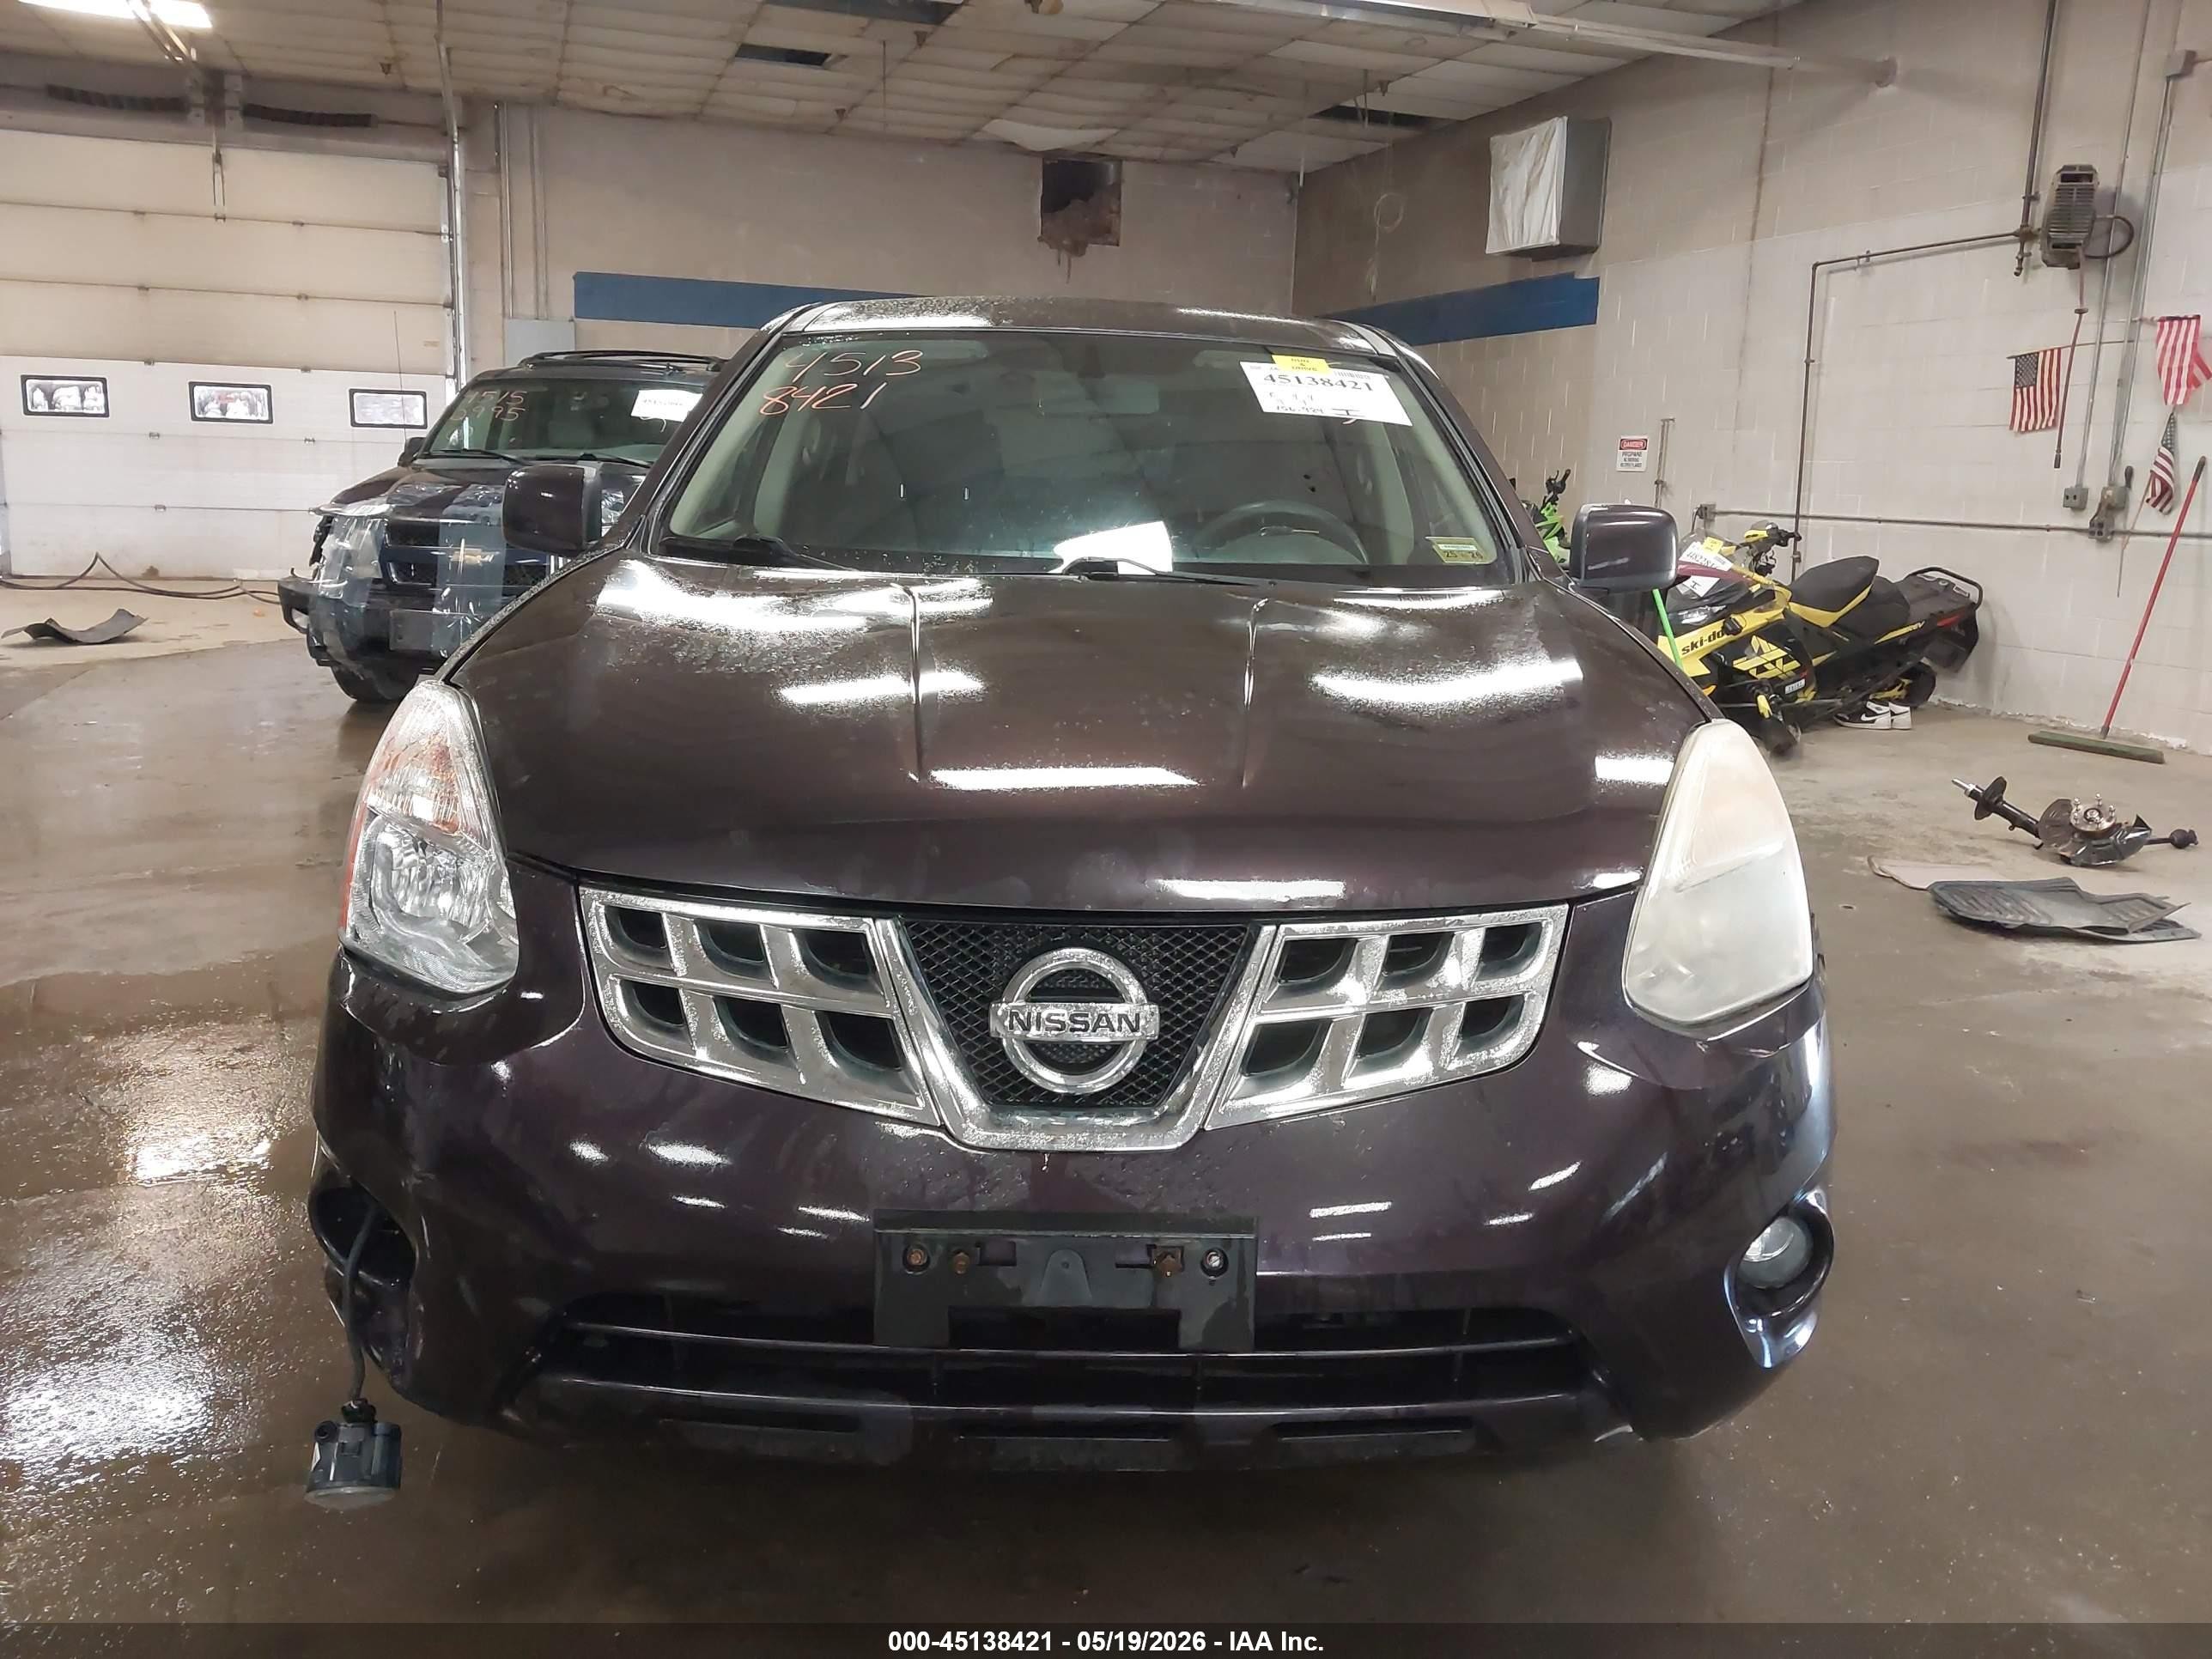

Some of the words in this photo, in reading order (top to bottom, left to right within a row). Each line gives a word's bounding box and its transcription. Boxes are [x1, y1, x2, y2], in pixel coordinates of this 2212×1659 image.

[785, 349, 924, 383] 4513
[1263, 374, 1373, 392] 45138421
[759, 382, 888, 416] 8421
[1681, 629, 1725, 655] ski-do
[1008, 1011, 1140, 1033] NISSAN
